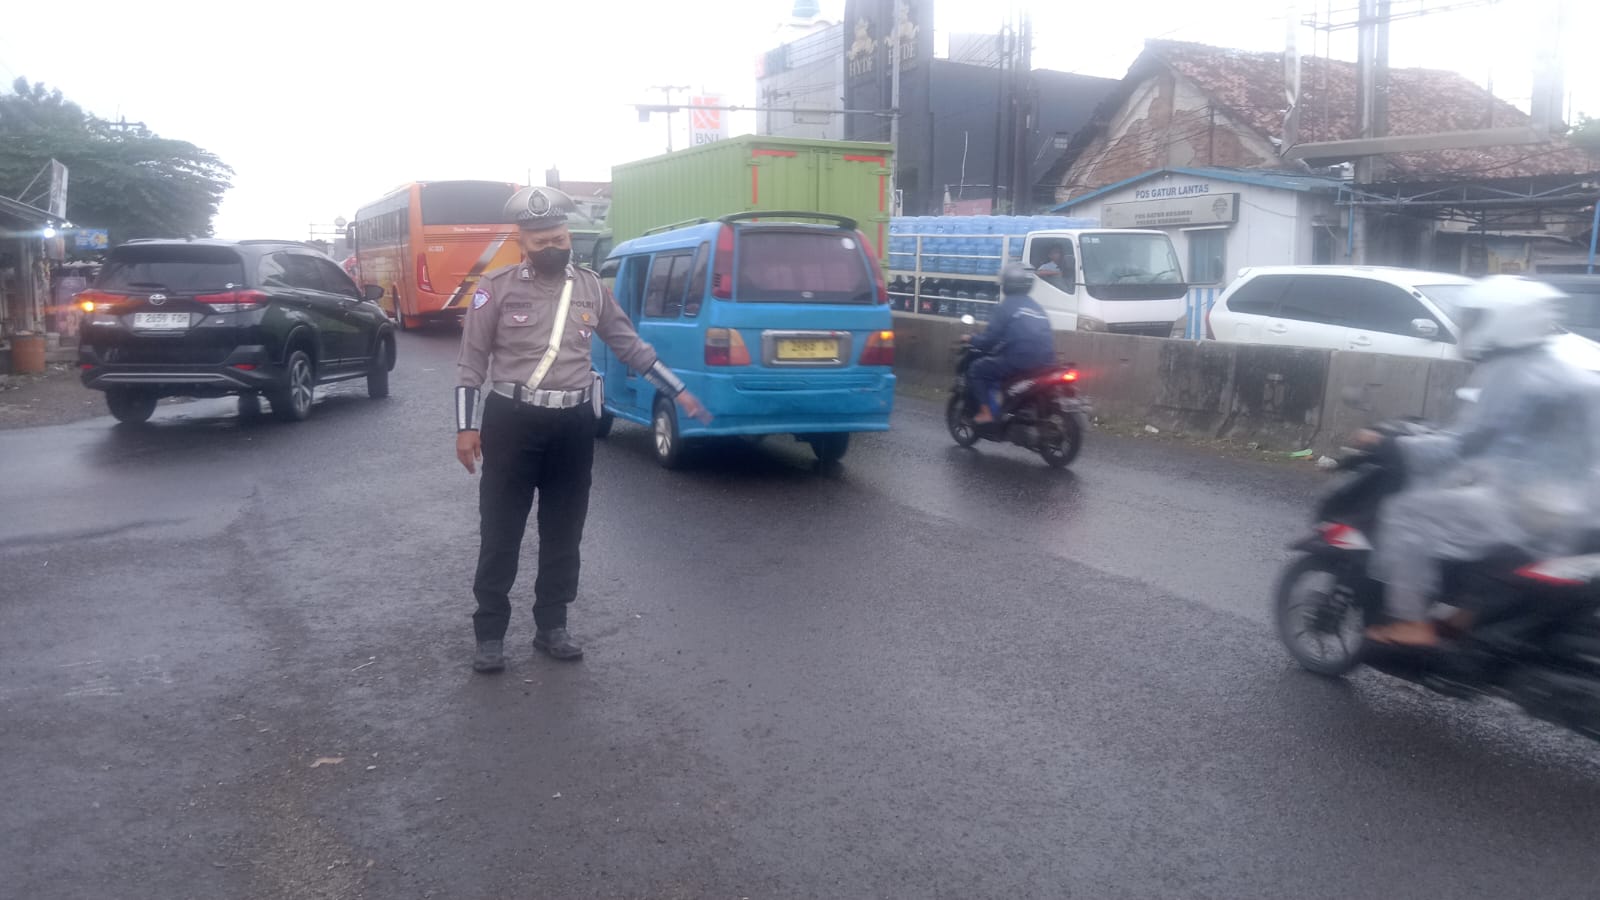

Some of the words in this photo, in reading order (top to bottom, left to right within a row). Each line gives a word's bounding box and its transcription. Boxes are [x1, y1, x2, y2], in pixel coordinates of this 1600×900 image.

[696, 132, 719, 144] BNI
[1136, 191, 1150, 199] POS
[1152, 187, 1177, 197] GATUR
[1179, 184, 1208, 195] LANTAS
[571, 301, 594, 309] POLRI
